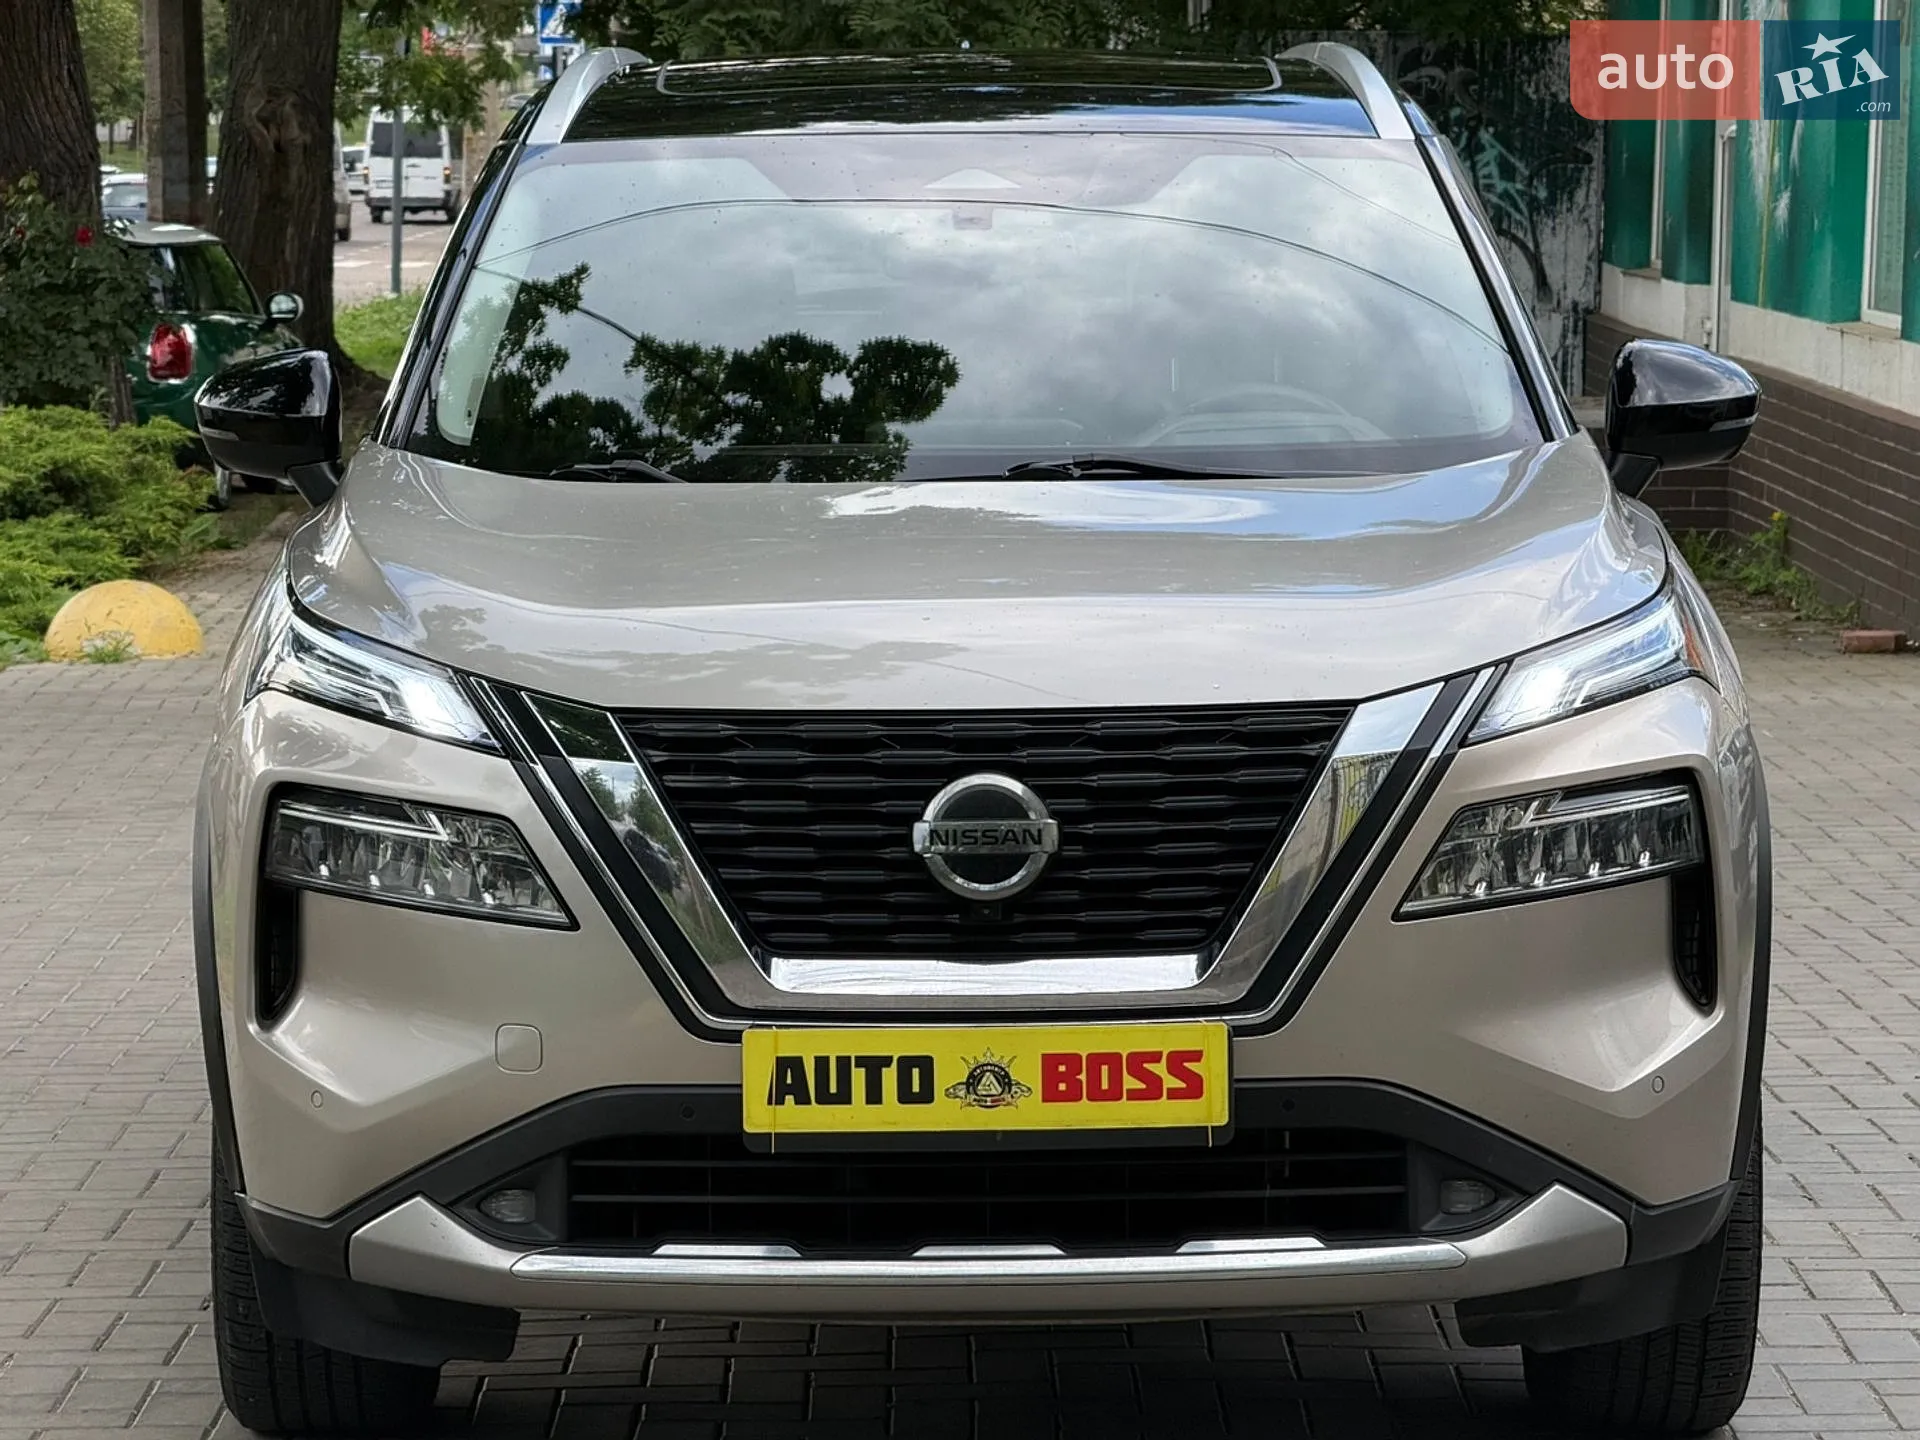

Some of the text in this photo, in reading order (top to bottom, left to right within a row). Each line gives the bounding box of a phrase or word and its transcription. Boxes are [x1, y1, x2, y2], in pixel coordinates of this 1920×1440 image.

[929, 828, 1042, 846] NISSAN
[767, 1049, 1203, 1105] AUTO BOSS
